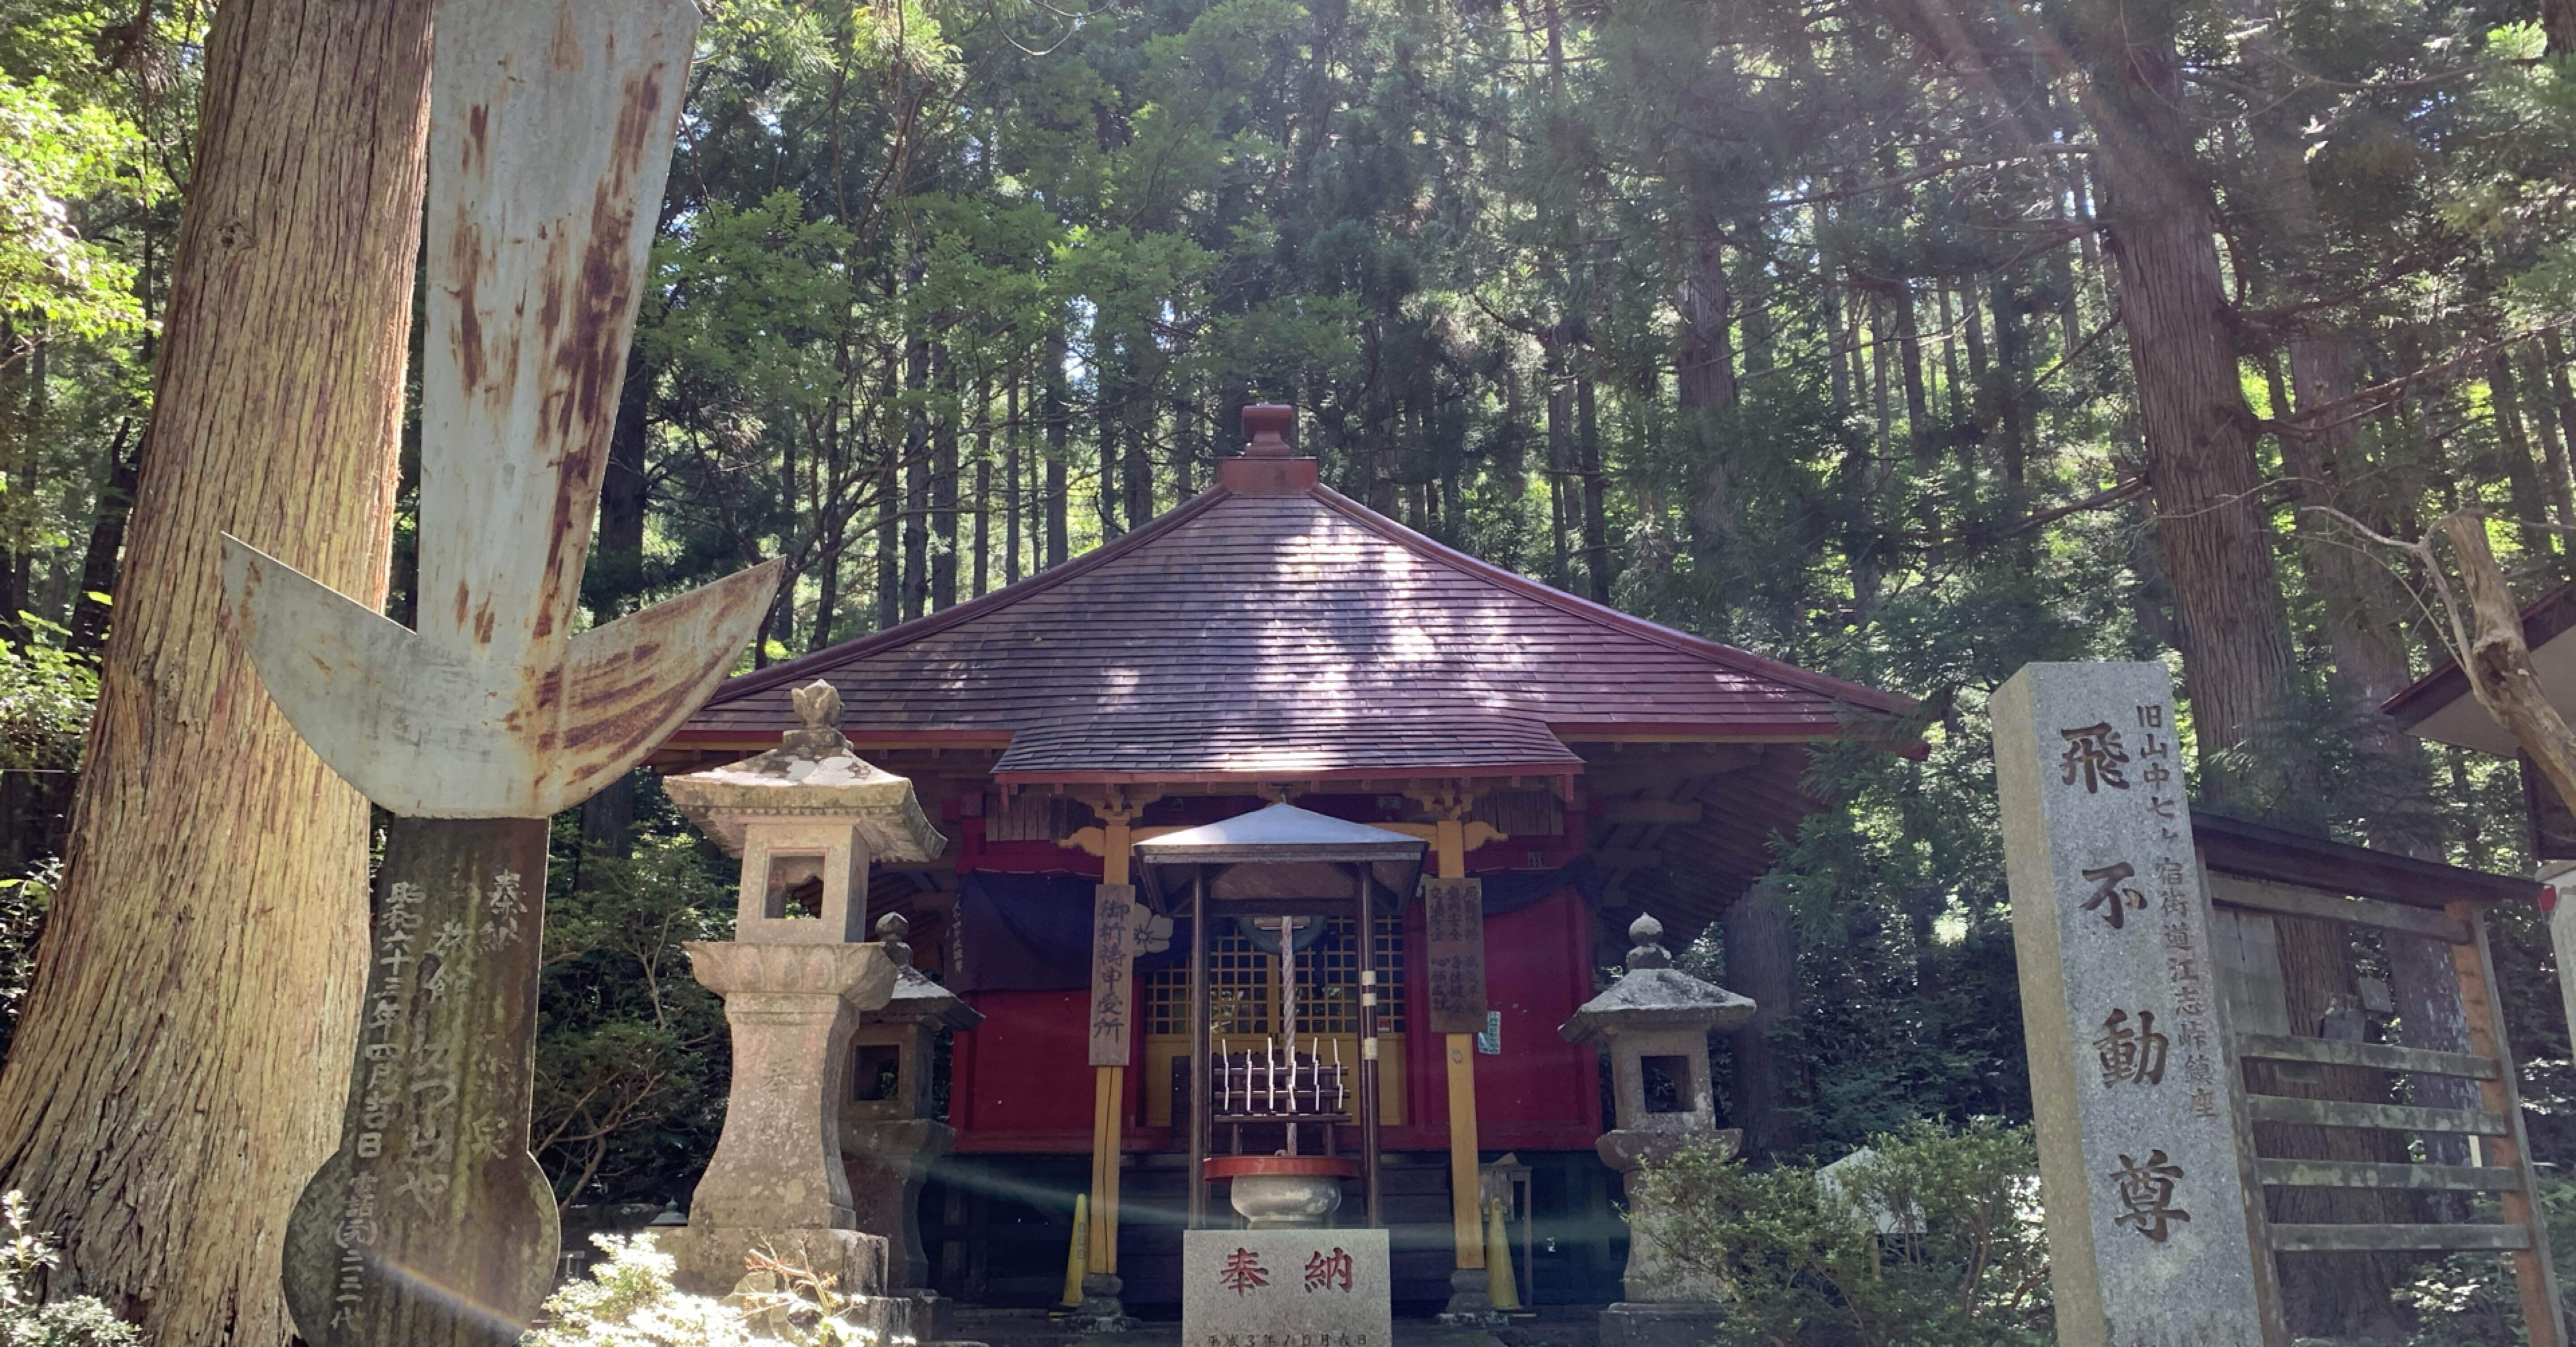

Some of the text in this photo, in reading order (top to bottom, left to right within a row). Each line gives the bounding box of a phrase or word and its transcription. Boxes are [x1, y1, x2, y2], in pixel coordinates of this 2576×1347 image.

[2060, 722, 2191, 1242] 飛不動尊
[1219, 1247, 1353, 1296] 奉納
